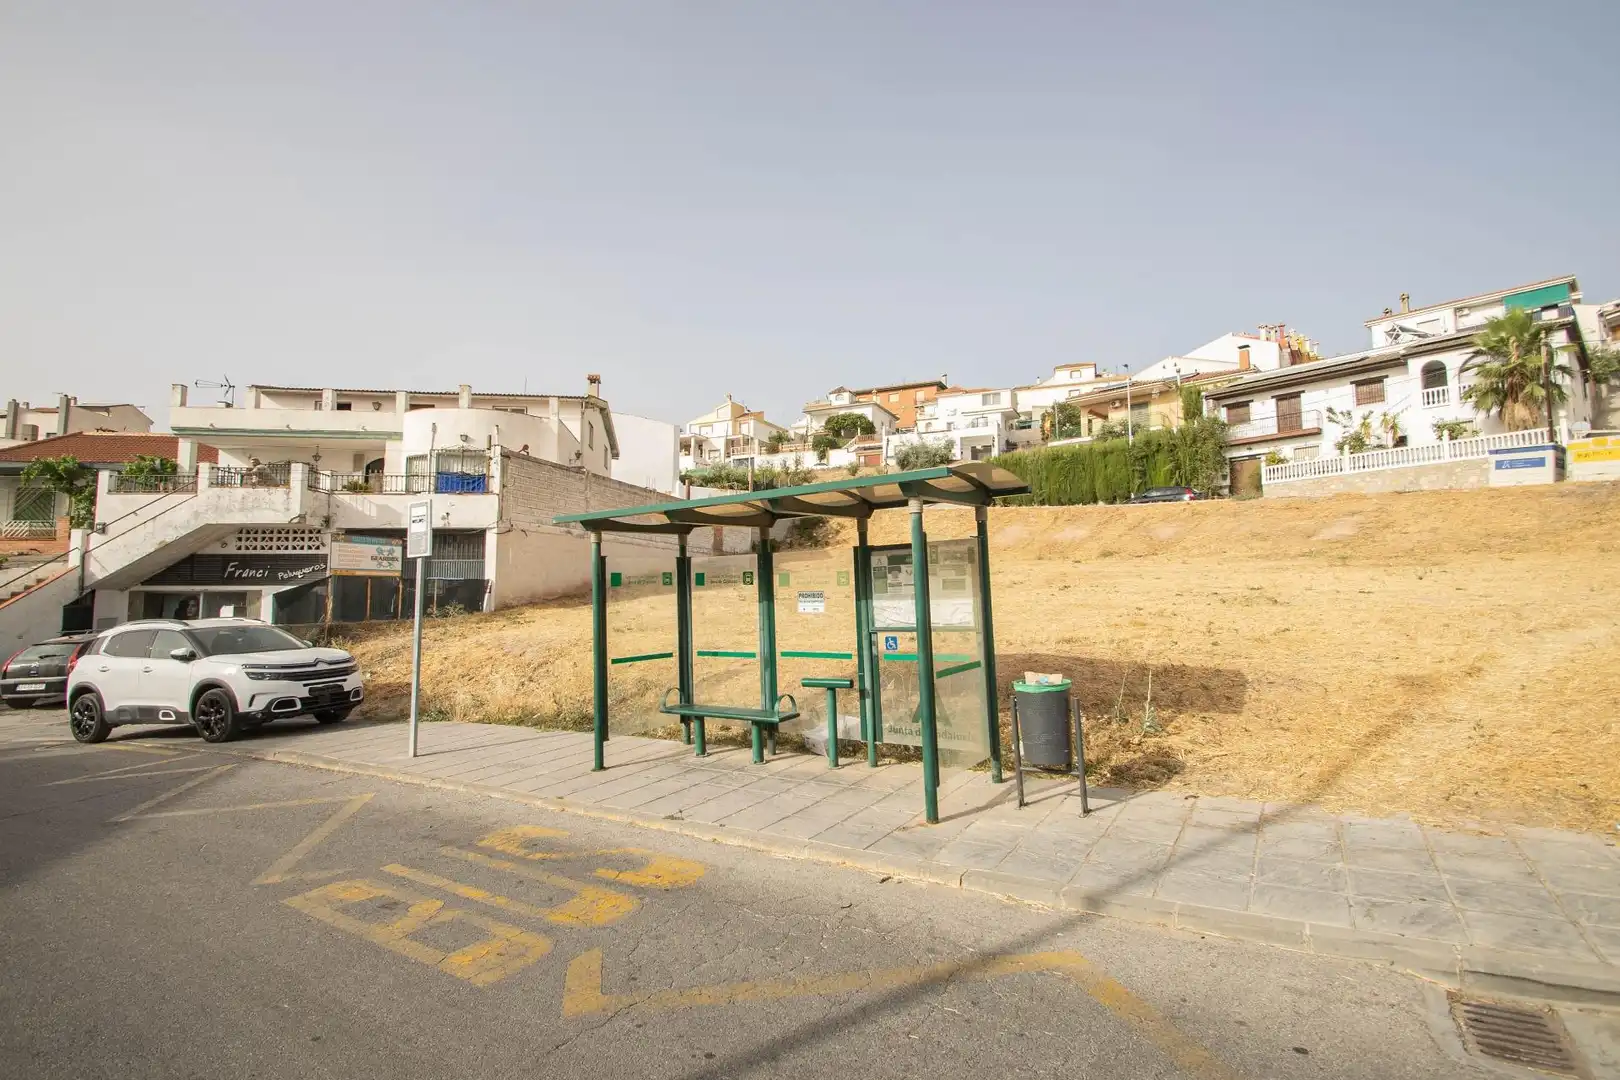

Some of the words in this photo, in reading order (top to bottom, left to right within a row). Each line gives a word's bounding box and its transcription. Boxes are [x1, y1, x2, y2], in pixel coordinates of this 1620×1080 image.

[224, 562, 271, 578] Franci
[887, 724, 913, 736] Junta
[283, 824, 706, 987] BUS
